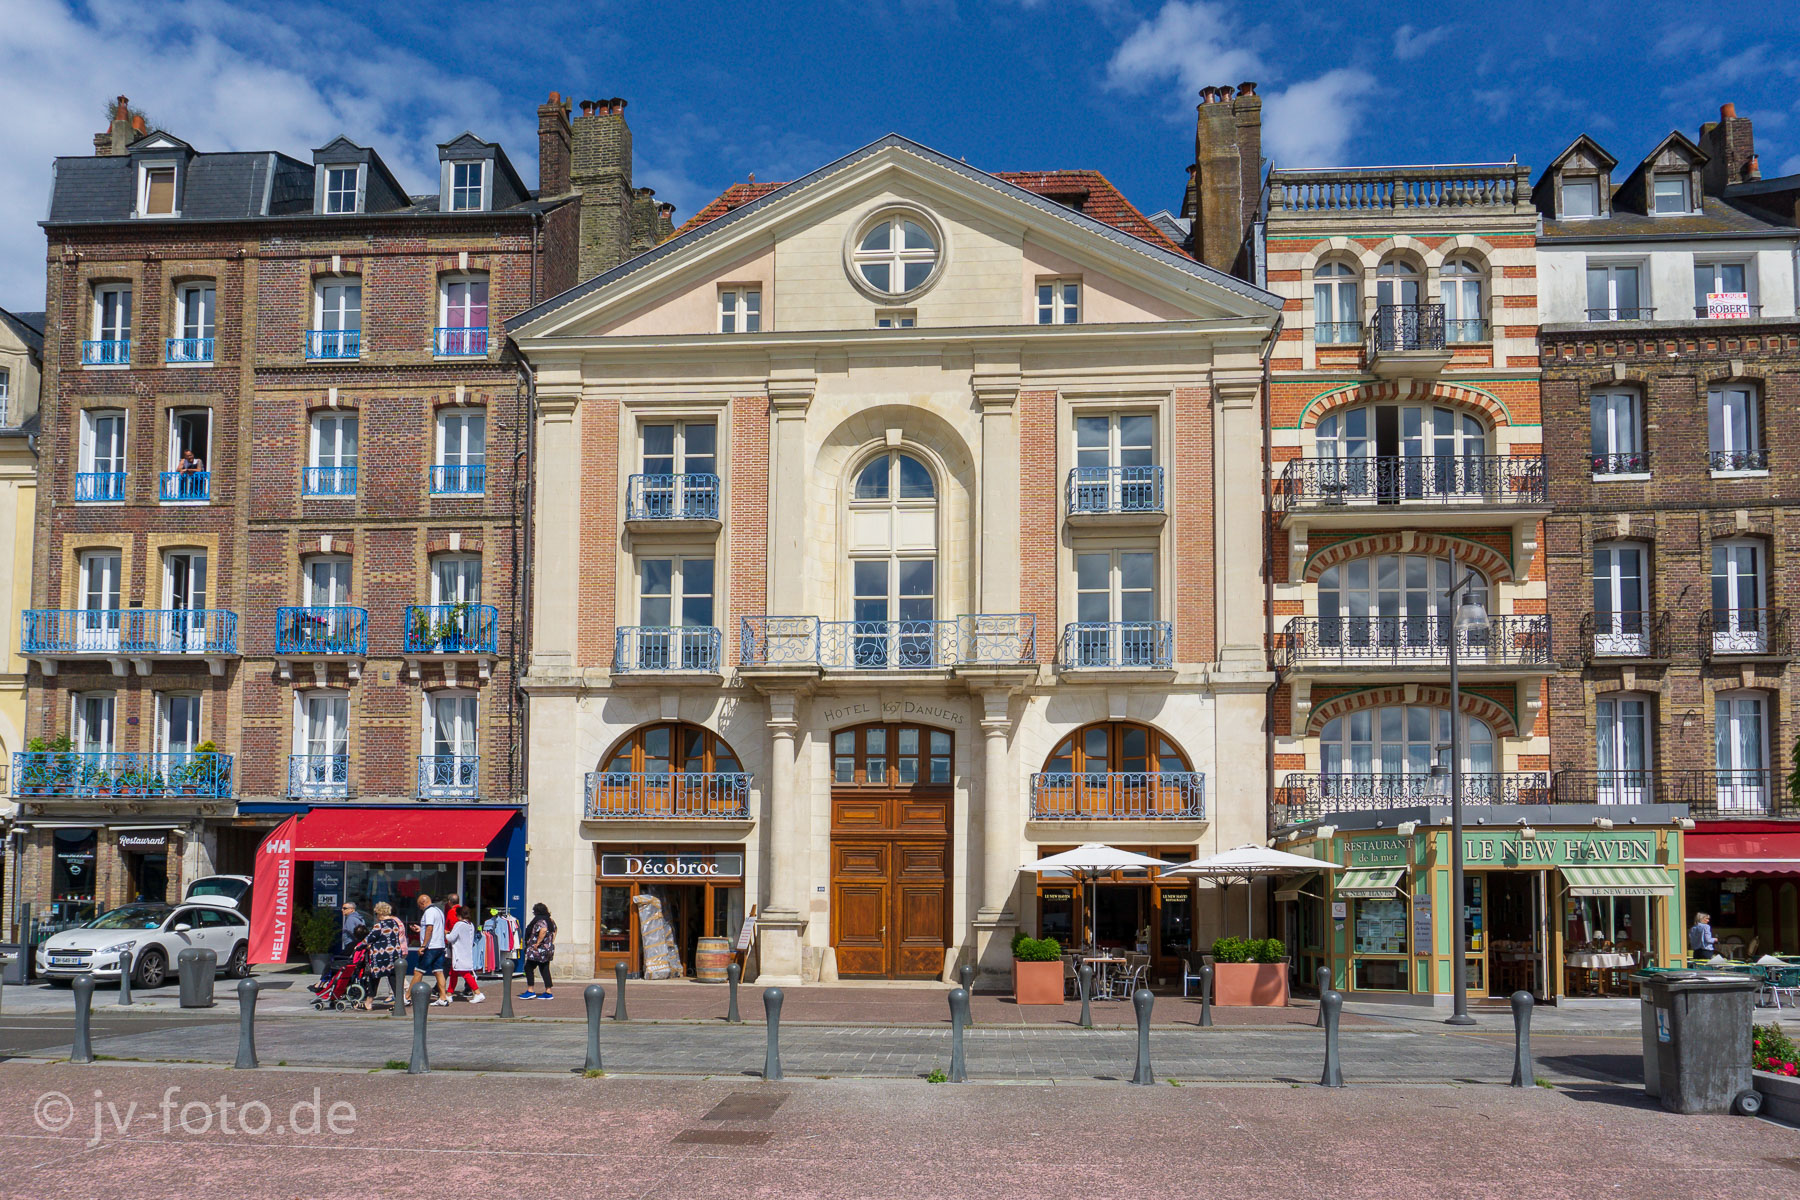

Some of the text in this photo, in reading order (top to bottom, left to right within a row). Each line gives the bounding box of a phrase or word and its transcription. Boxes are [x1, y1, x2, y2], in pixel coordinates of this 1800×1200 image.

[1709, 304, 1748, 314] ROBERT
[824, 703, 870, 722] HOTEL
[882, 701, 901, 715] 1697
[119, 835, 165, 847] Restaurant
[266, 839, 291, 854] HH
[1343, 839, 1413, 852] RESTAURANT
[1358, 853, 1369, 862] de
[1371, 853, 1379, 862] la
[1465, 839, 1651, 861] LE NEW HAVEN
[624, 857, 719, 875] Décobroc
[270, 859, 290, 960] HELLY HANSEN
